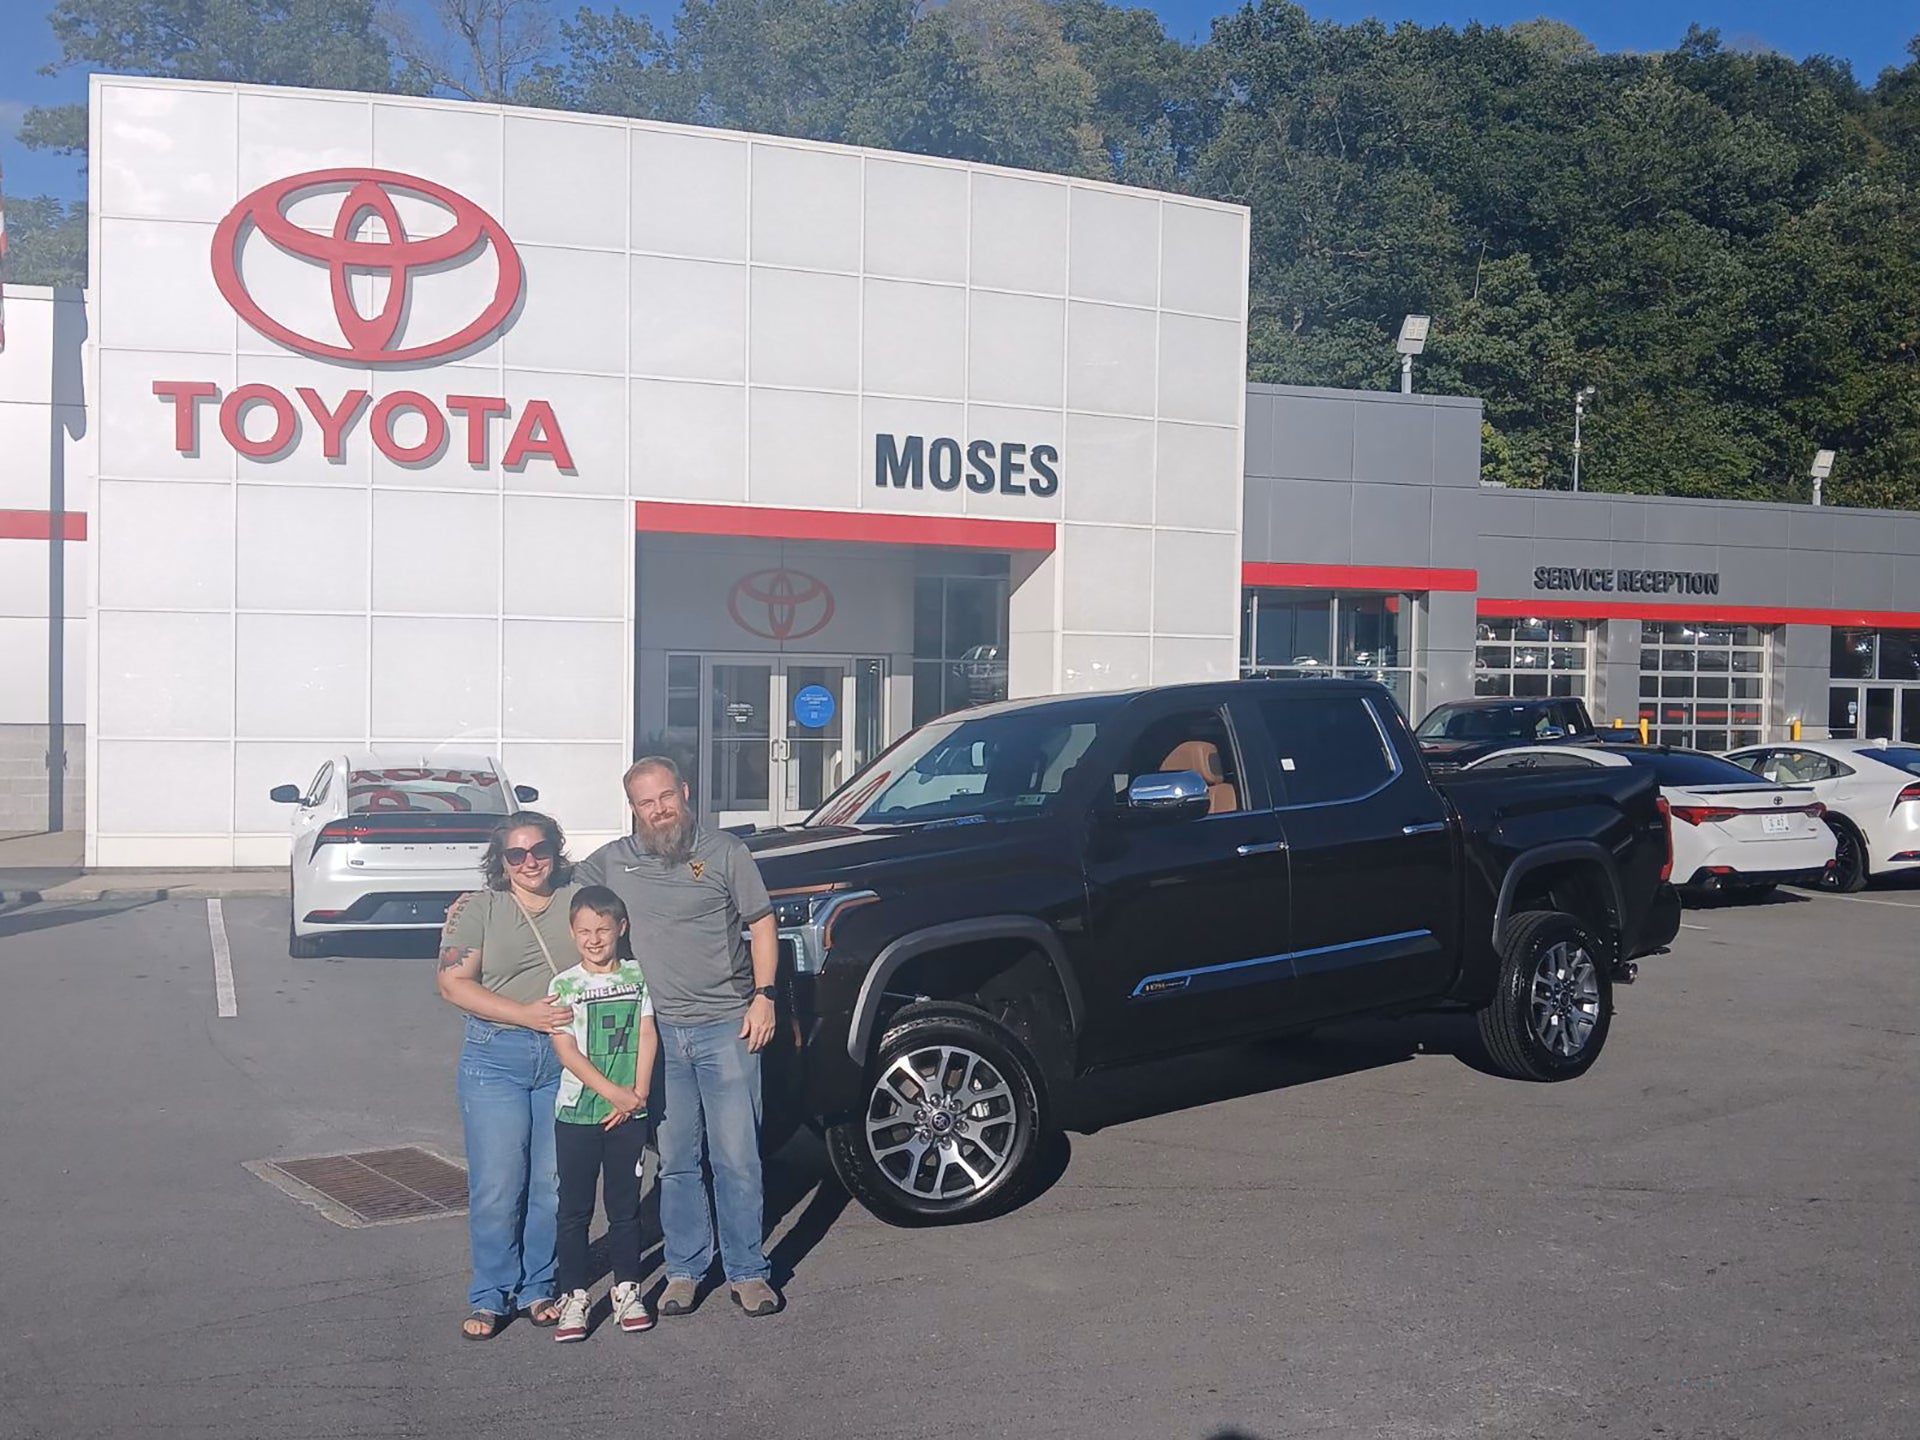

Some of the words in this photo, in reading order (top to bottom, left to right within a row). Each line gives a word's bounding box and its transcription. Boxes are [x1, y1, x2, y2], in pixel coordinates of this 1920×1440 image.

[152, 381, 578, 476] TOYOTA
[875, 433, 1058, 498] MOSES
[1534, 567, 1613, 592] SERVICE
[1617, 570, 1719, 595] RECEPTION
